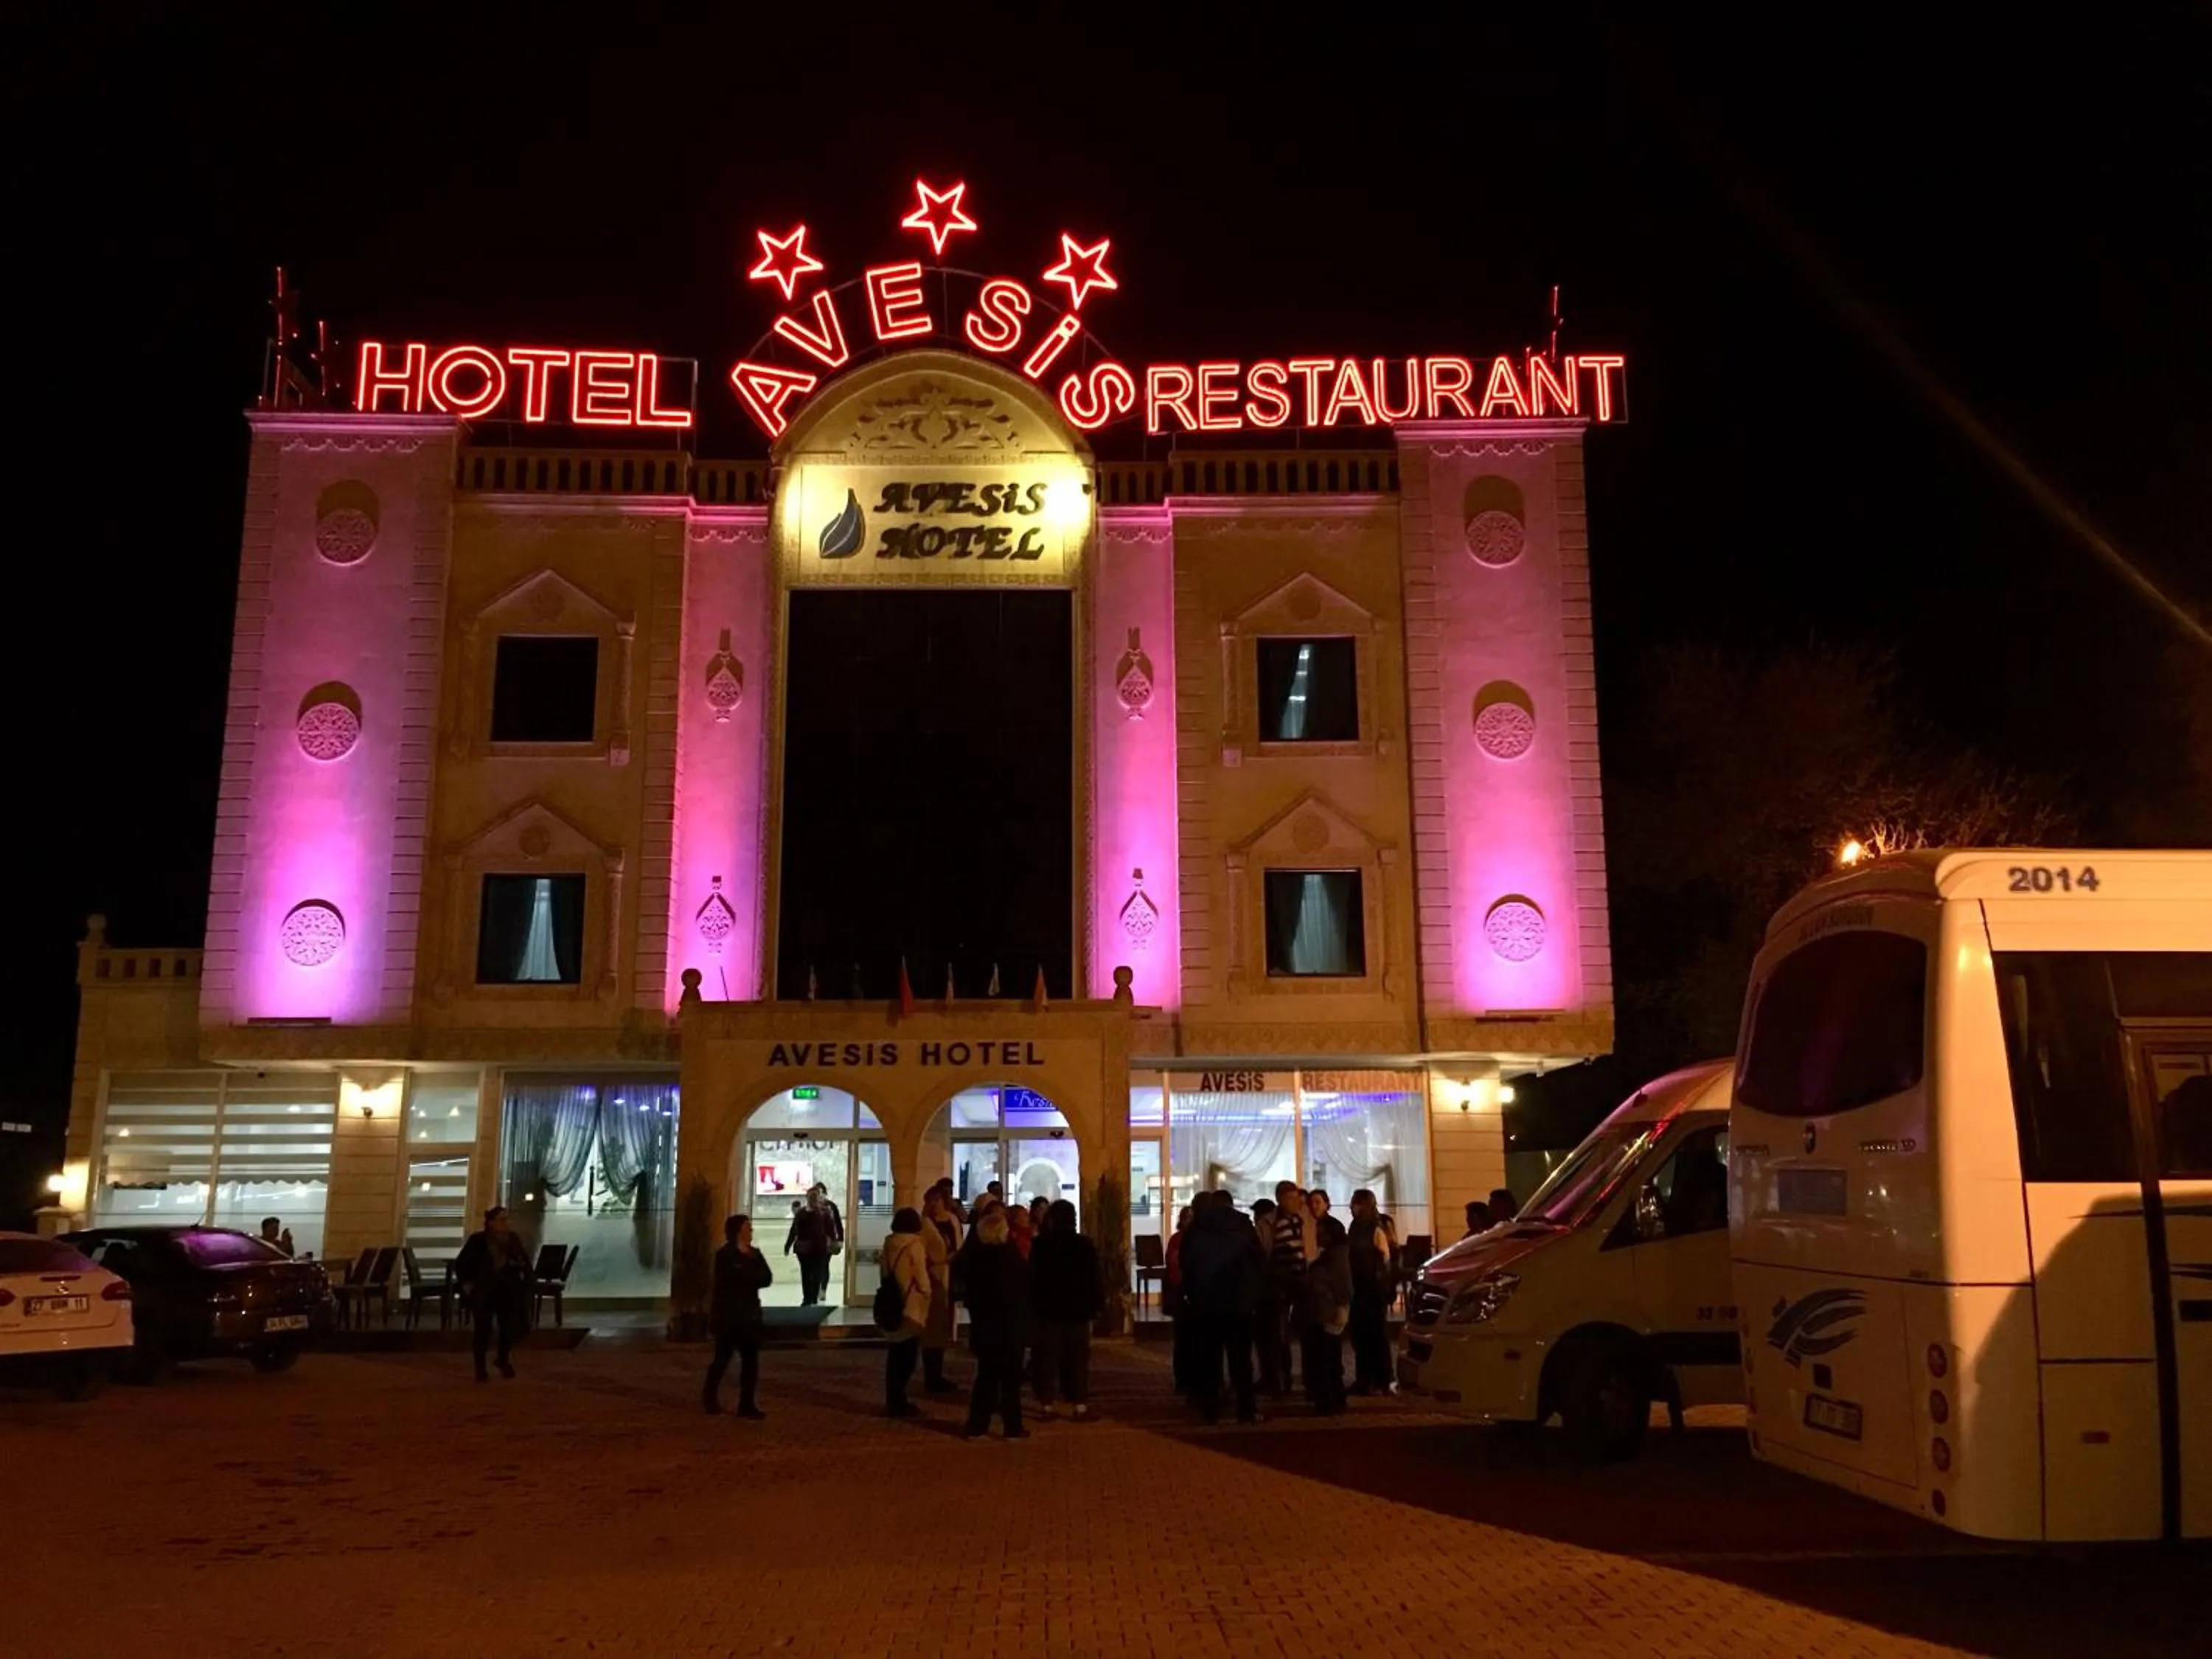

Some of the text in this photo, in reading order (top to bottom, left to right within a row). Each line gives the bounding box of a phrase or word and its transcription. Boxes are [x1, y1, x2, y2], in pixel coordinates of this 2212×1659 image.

[356, 342, 693, 428] HOTEL
[1147, 355, 1624, 434] RESTAURANT
[877, 523, 1046, 560] HOTEL
[2008, 866, 2100, 892] 2014
[920, 1041, 1045, 1065] HOTEL
[1302, 1072, 1421, 1091] RESTAURANT
